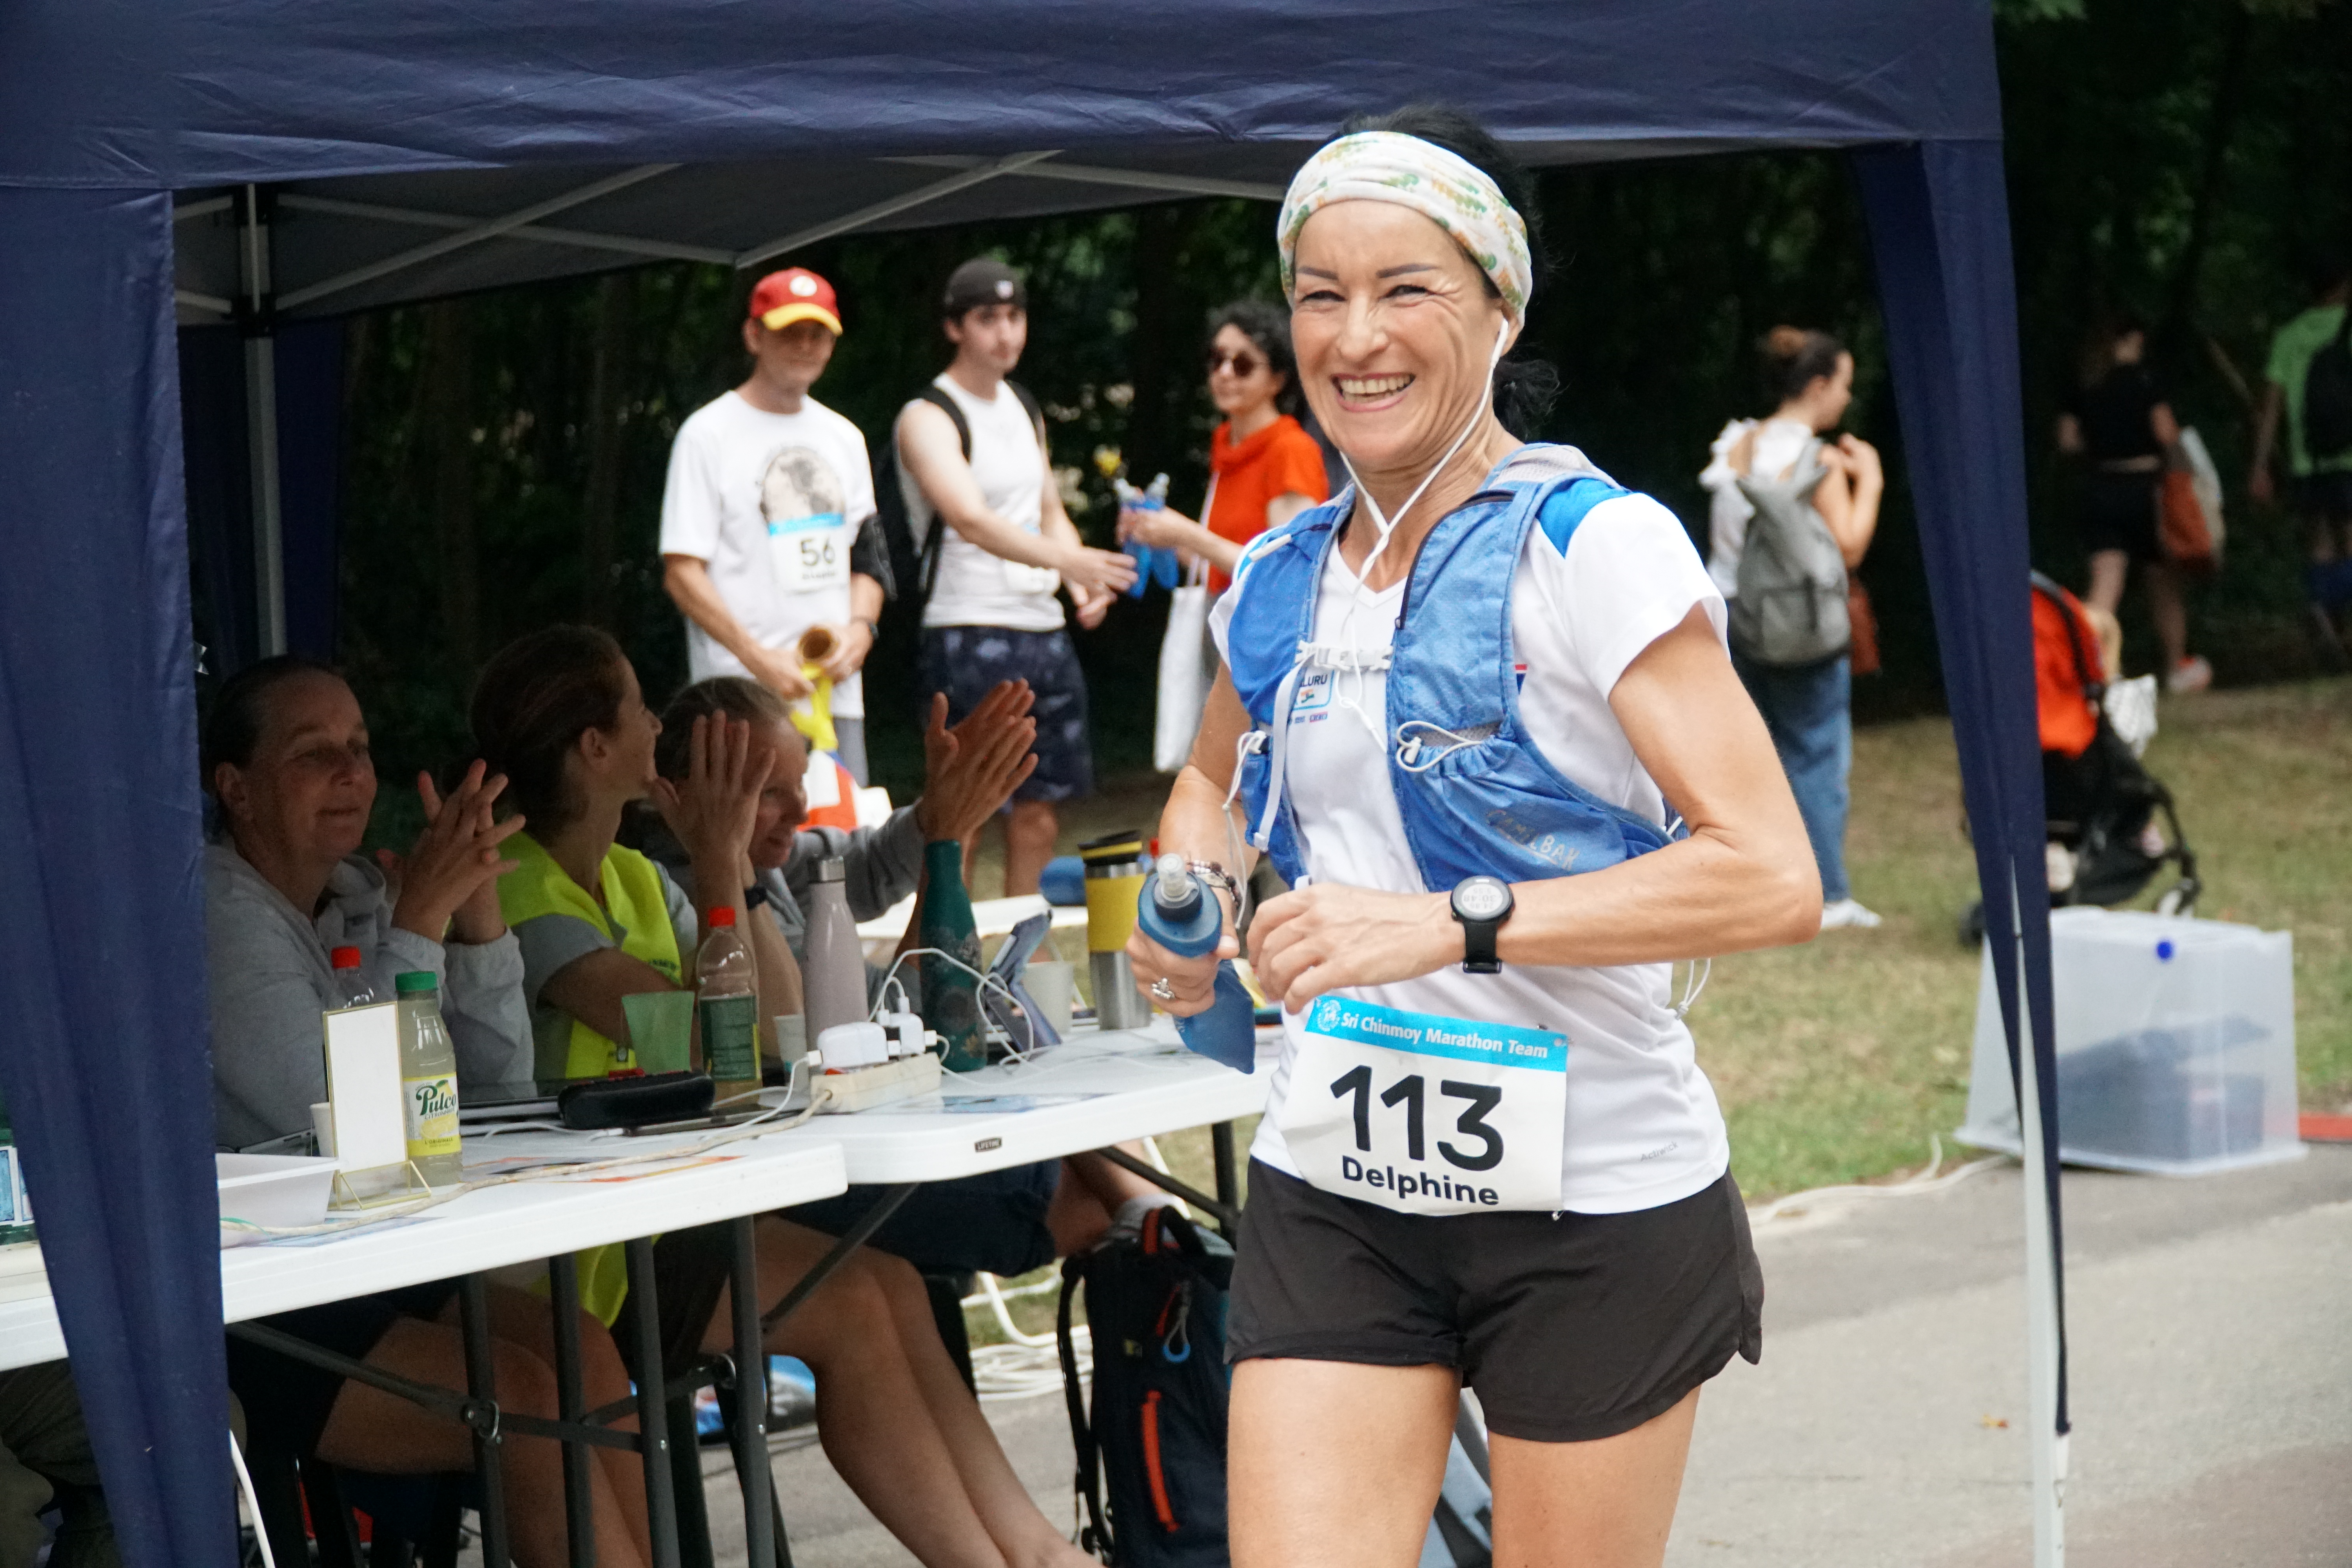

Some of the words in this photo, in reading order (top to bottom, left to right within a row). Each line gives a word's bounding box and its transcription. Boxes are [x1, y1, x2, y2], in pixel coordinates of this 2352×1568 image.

[800, 536, 836, 566] 56
[1341, 1013, 1357, 1029] Sri
[1361, 1017, 1422, 1044] Chinmoy
[1426, 1028, 1503, 1052] Marathon
[1508, 1039, 1548, 1058] Team
[416, 1085, 456, 1116] Pulco
[1330, 1065, 1504, 1171] 113
[1342, 1155, 1499, 1205] Delphine
